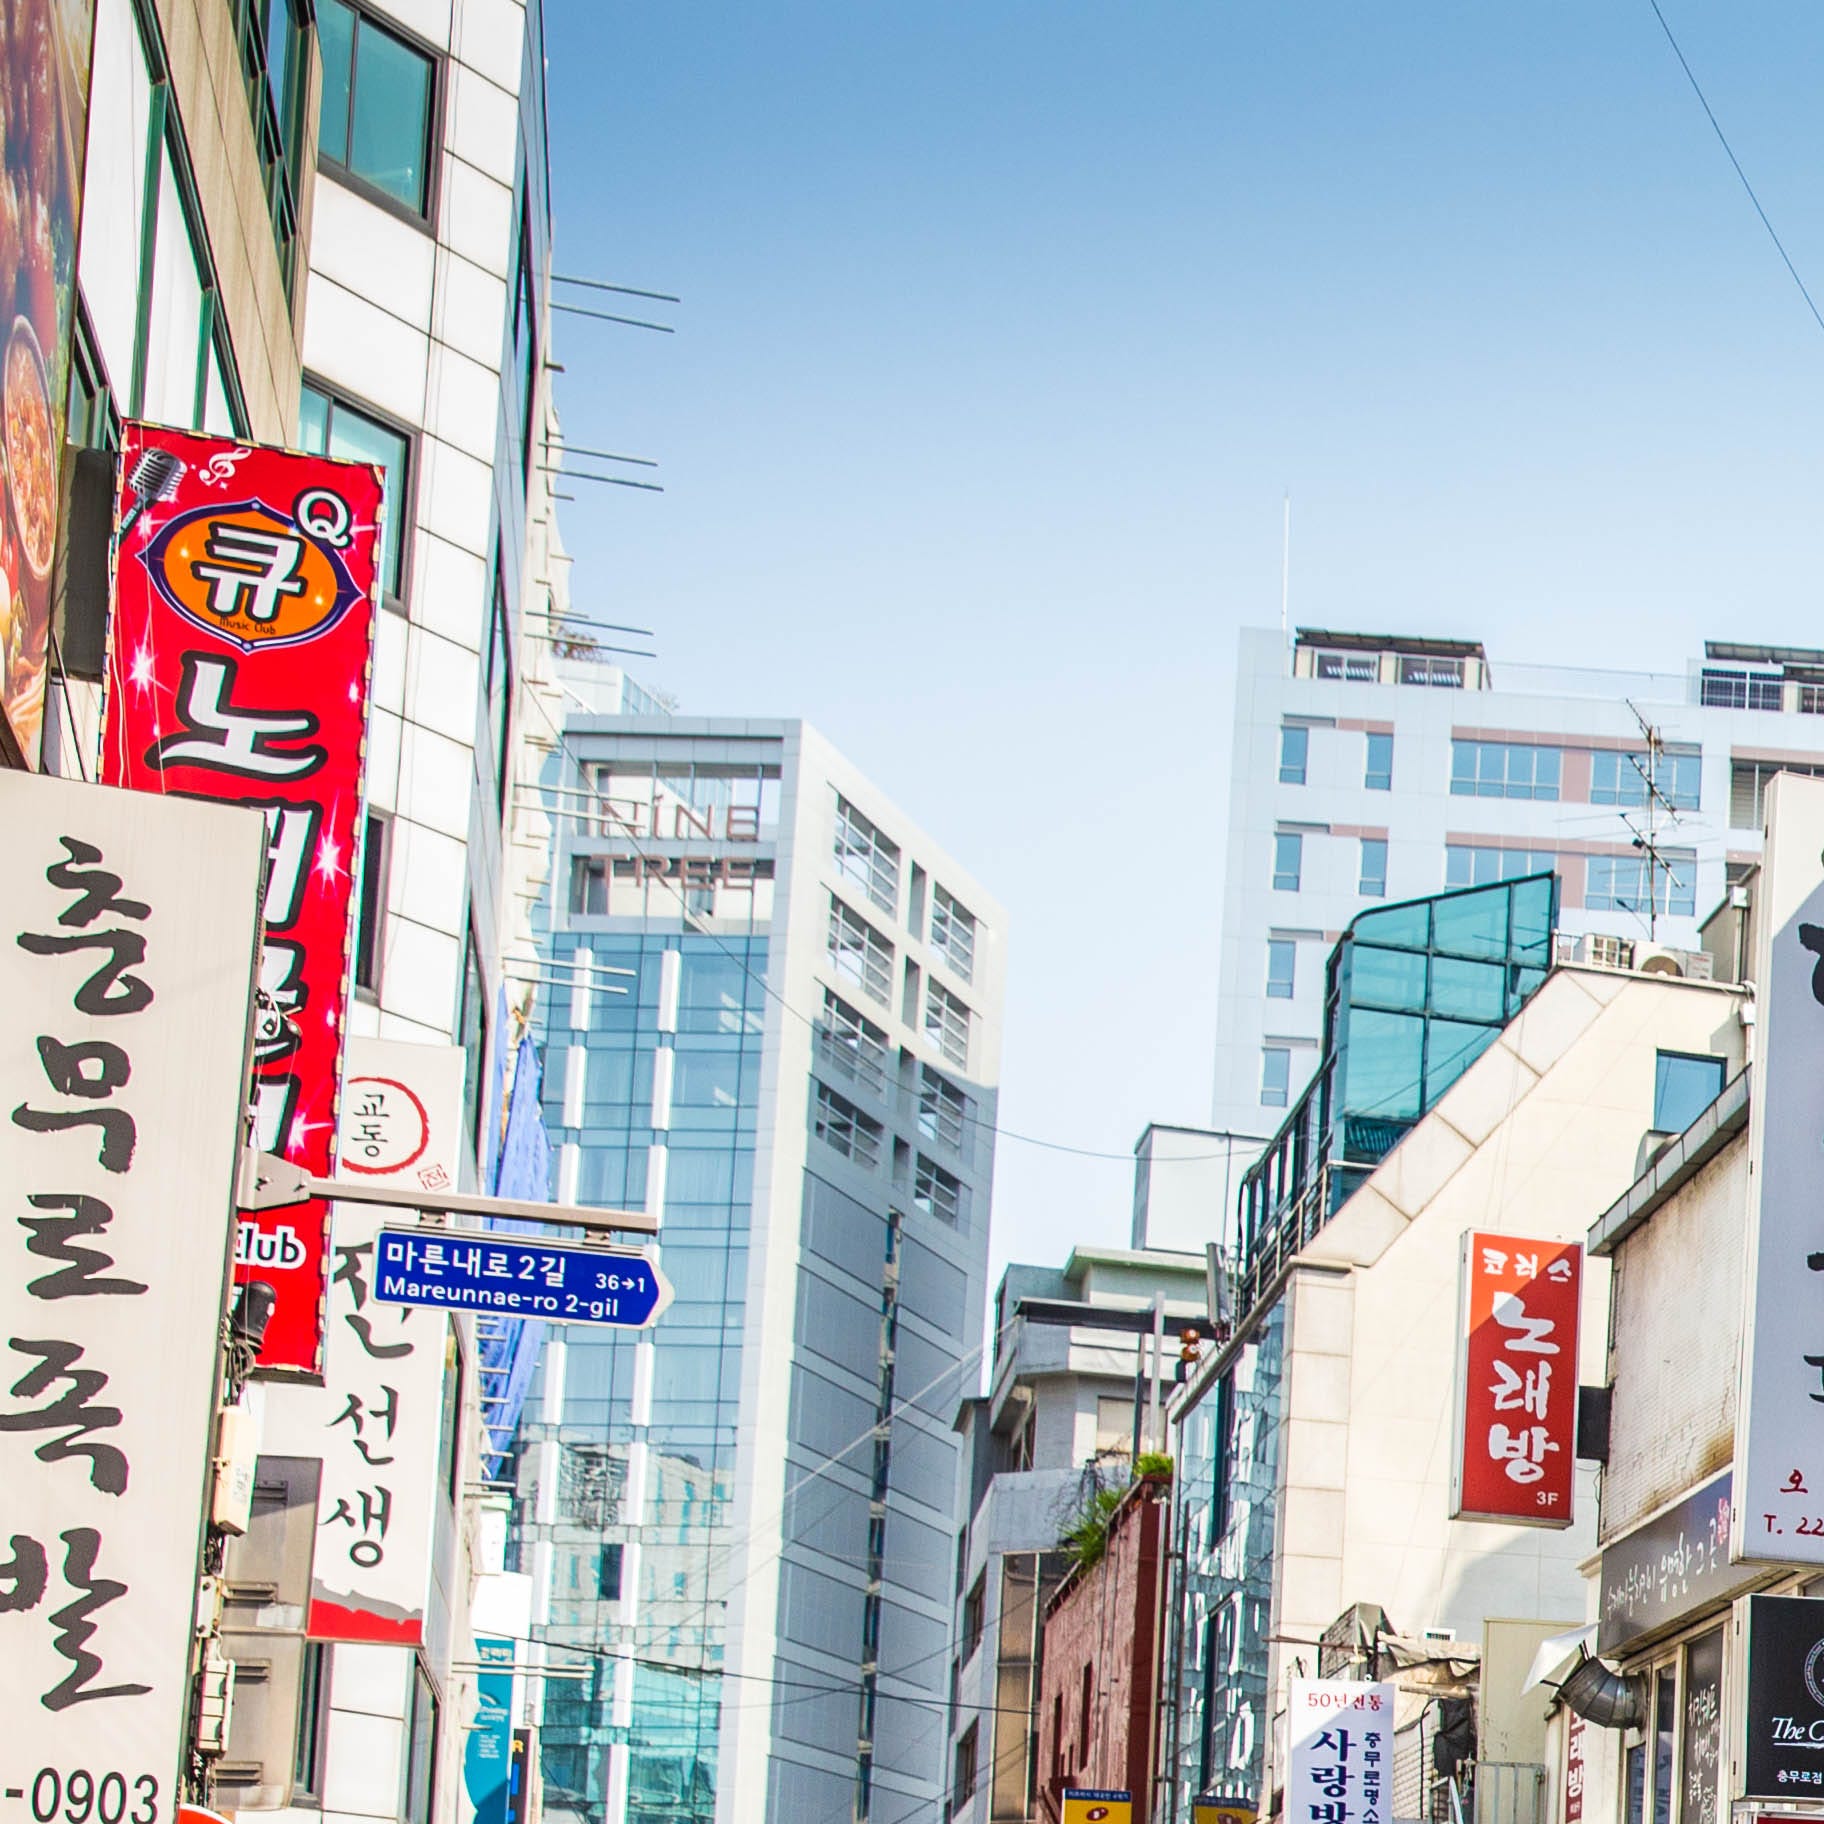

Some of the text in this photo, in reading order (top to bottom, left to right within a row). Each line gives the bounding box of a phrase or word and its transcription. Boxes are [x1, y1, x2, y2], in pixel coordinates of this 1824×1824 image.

[293, 488, 354, 550] Q
[190, 522, 308, 622] 큐
[384, 1277, 619, 1319] Mareunnae-ro 2-gil
[1489, 1290, 1561, 1484] 노래방
[1536, 1491, 1559, 1506] 3F
[1772, 1716, 1807, 1744] The
